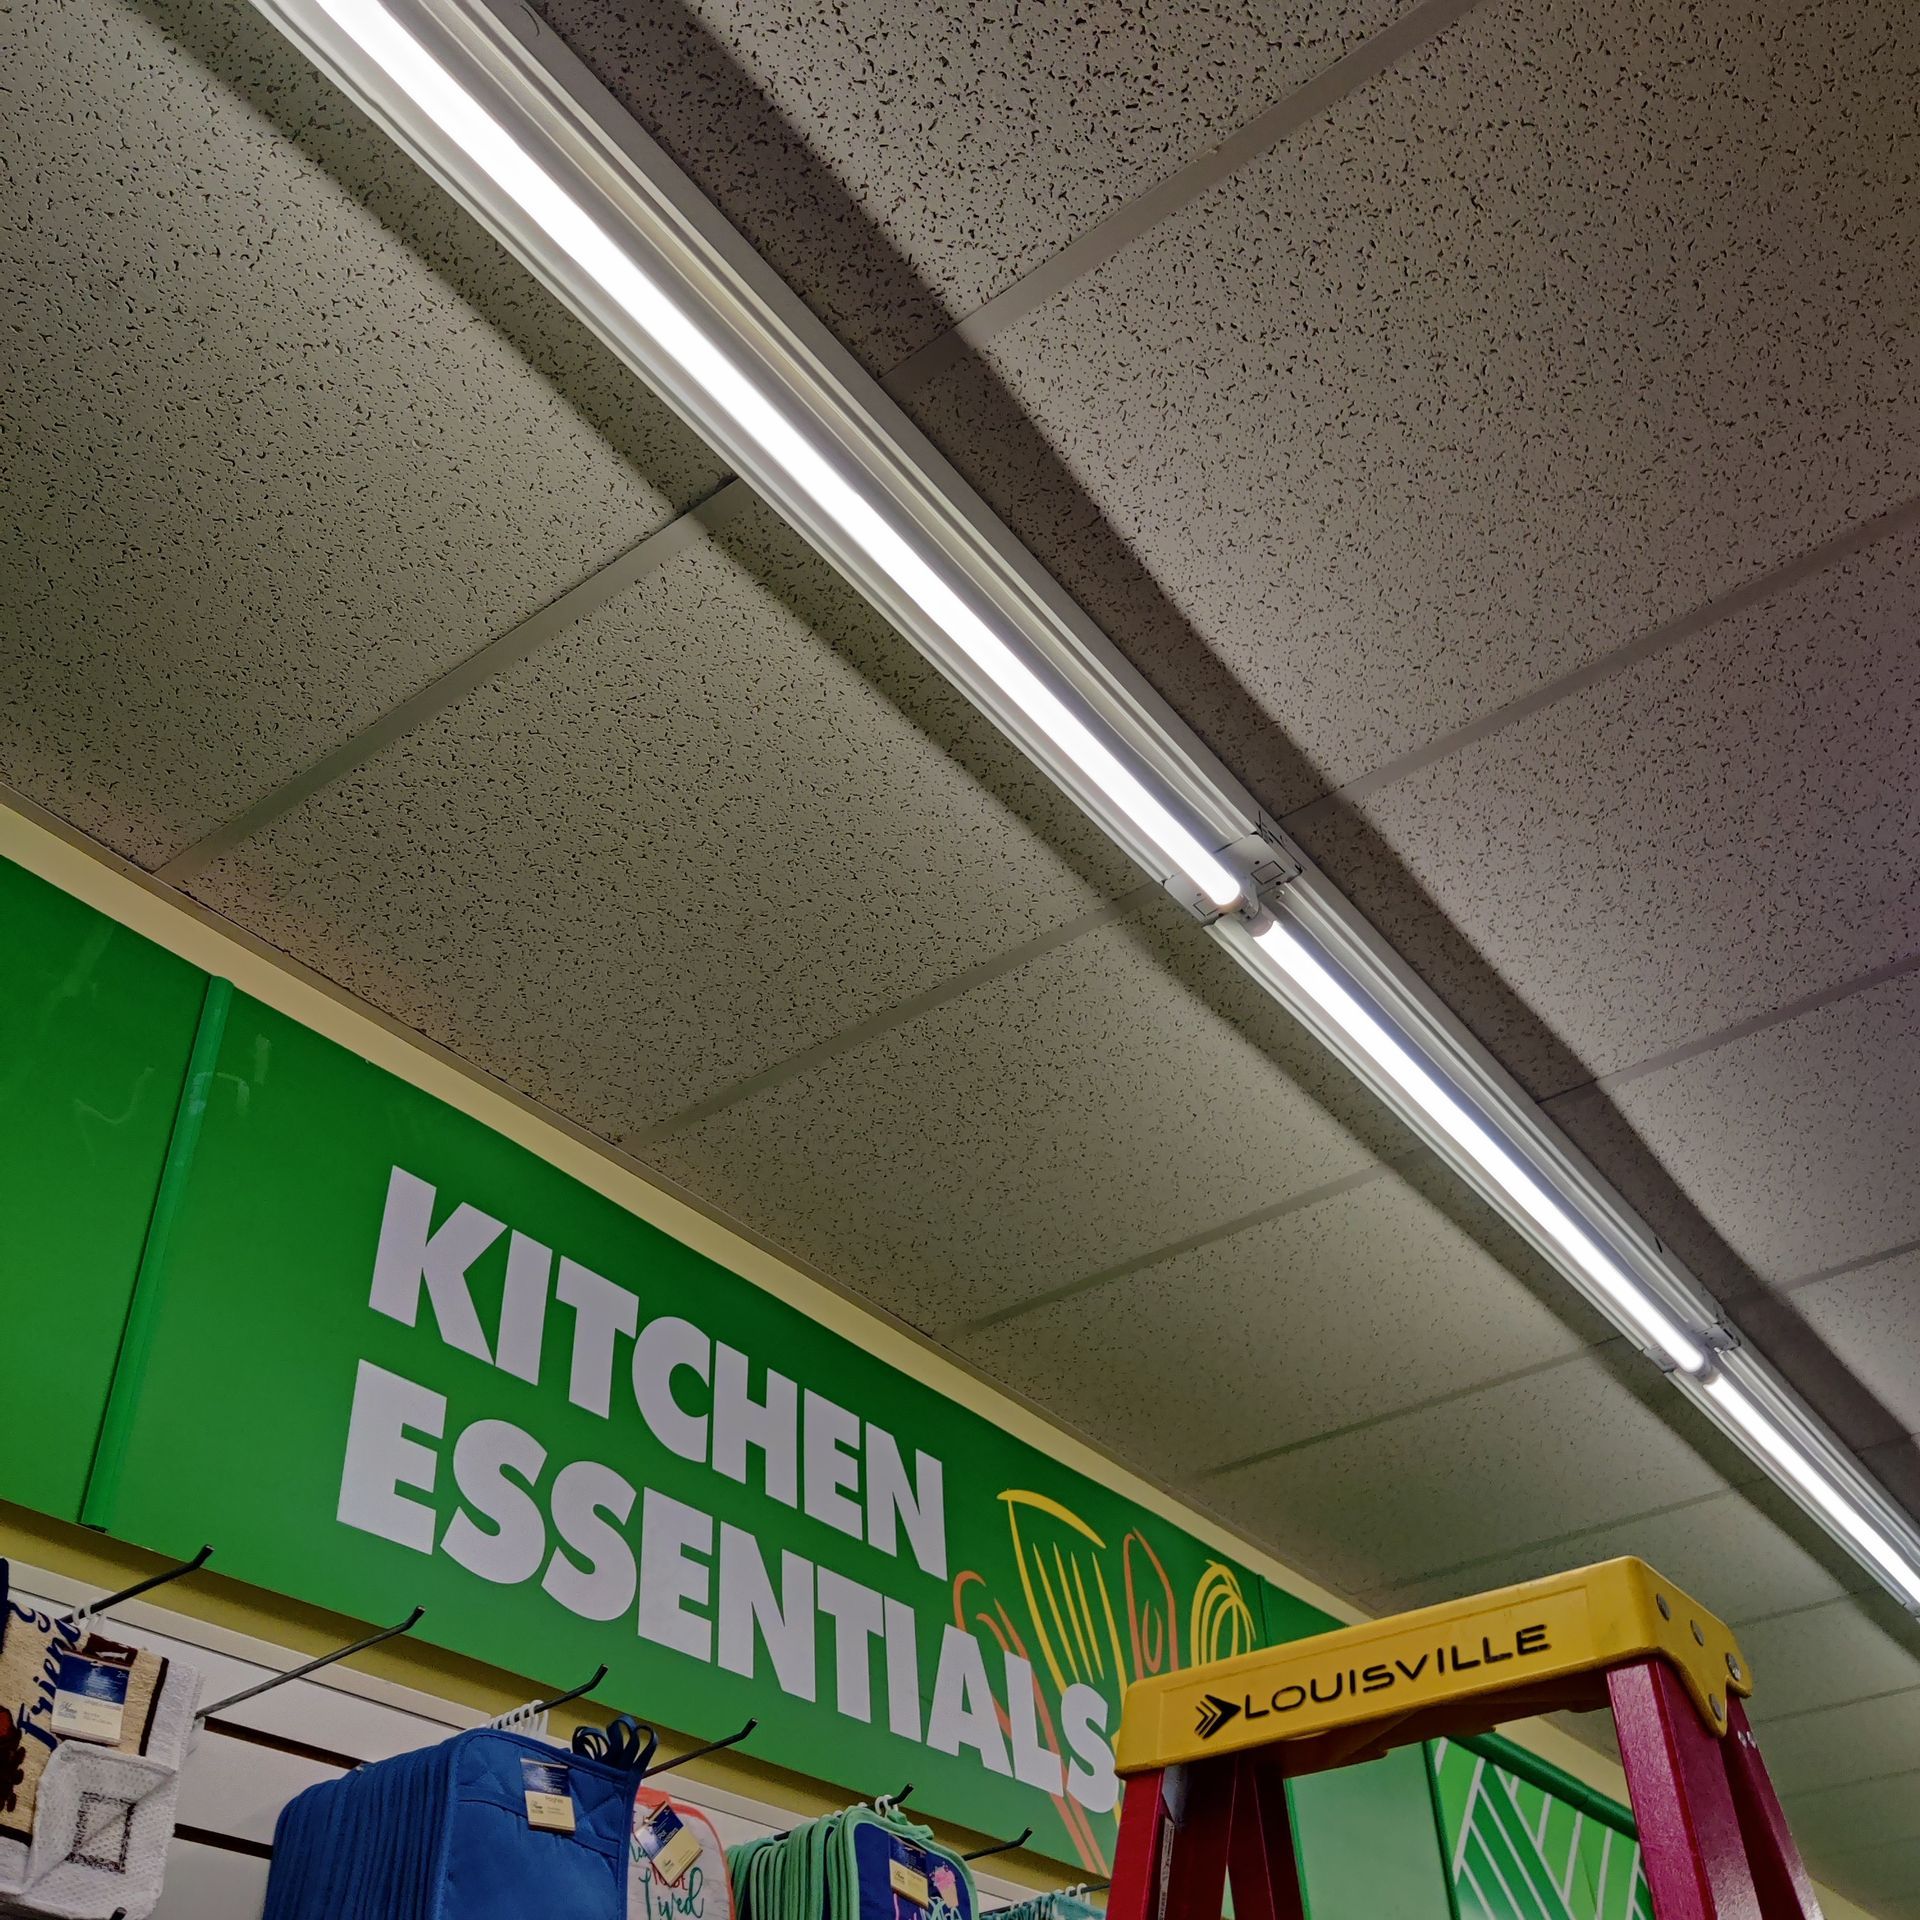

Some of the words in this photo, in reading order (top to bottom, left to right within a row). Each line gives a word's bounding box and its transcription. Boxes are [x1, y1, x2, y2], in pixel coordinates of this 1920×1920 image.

[369, 1165, 948, 1581] KITCHEN
[336, 1358, 1119, 1813] ESSENTIALS
[1244, 1623, 1552, 1720] LOUISVILLE
